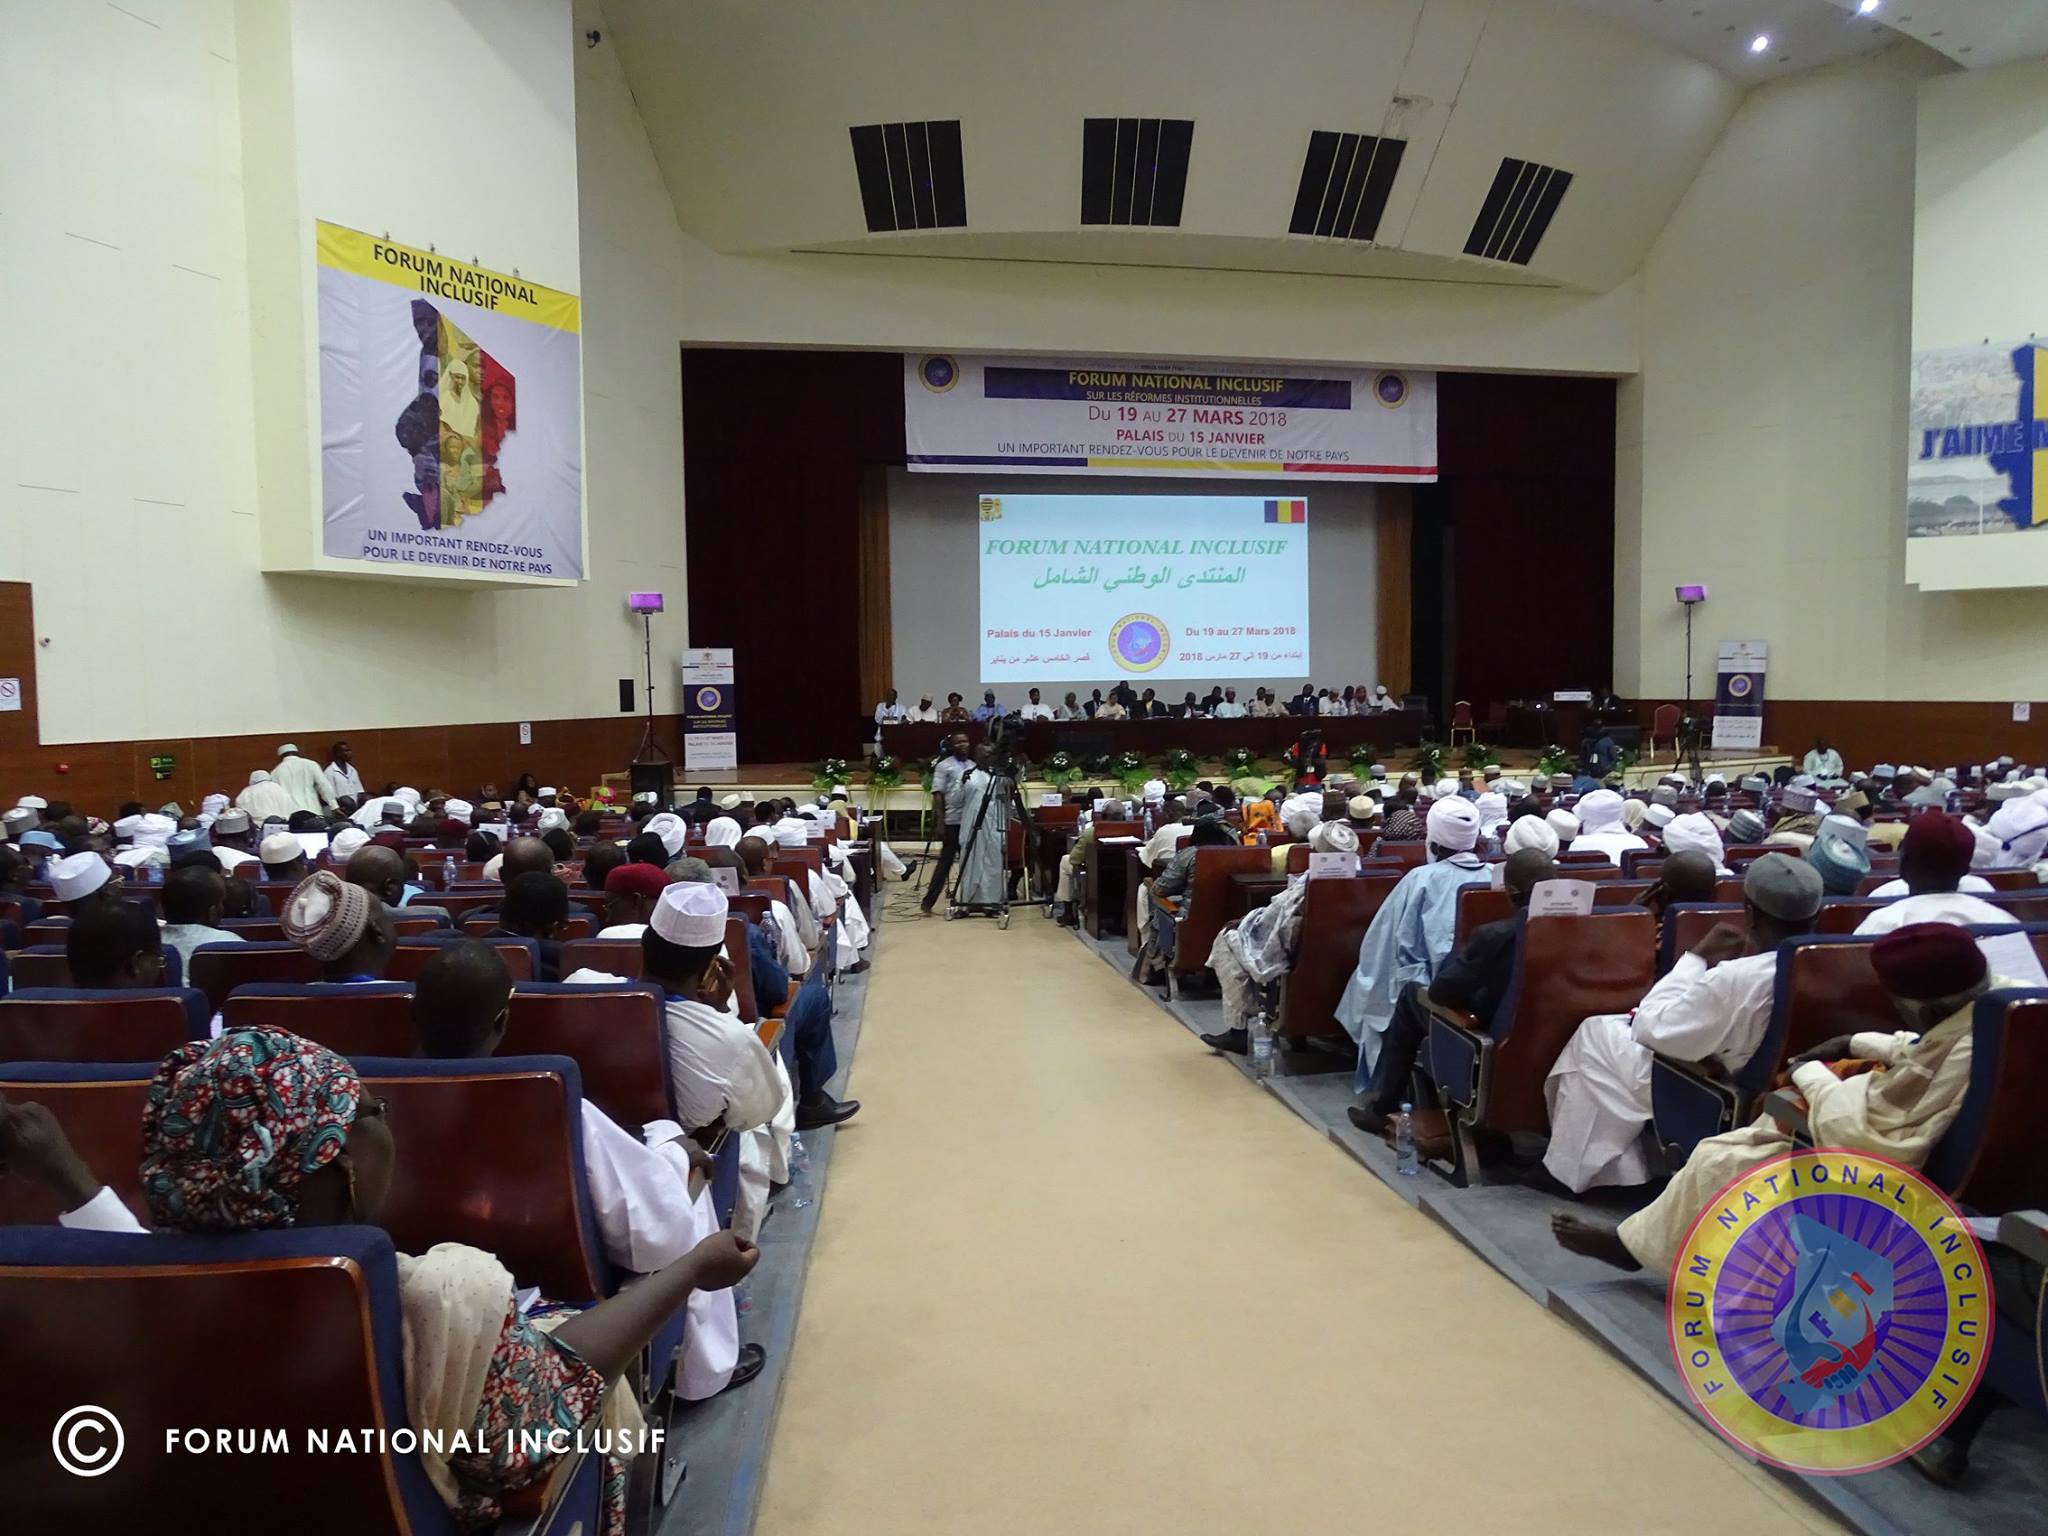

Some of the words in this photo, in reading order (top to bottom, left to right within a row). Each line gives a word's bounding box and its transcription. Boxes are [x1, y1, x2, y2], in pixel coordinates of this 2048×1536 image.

[373, 244, 443, 278] FORUM
[450, 265, 538, 305] NATIONAL
[420, 276, 500, 310] INCLUSIF
[1069, 371, 1126, 387] FORUM
[1132, 374, 1212, 391] NATIONAL
[1216, 378, 1284, 393] INCLUSIF
[1086, 391, 1105, 400] SUR
[1107, 392, 1122, 401] LES
[1124, 390, 1172, 403] RÉFORMES
[1118, 406, 1137, 422] 19
[1142, 411, 1161, 422] AU
[1167, 408, 1187, 423] 27
[1193, 409, 1244, 425] MARS
[1249, 412, 1287, 427] 2018
[1116, 429, 1164, 442] PALAIS
[1169, 432, 1185, 443] DU
[1189, 431, 1204, 443] 15
[1208, 433, 1265, 445] JANVIER
[998, 442, 1015, 453] UN
[1019, 443, 1085, 455] IMPORTANT
[1089, 445, 1168, 457] RENDEZ-VOUS
[1172, 447, 1201, 457] POUR
[1206, 448, 1218, 457] LE
[1221, 448, 1266, 459] DEVENIR
[1270, 449, 1283, 459] DE
[1287, 450, 1322, 461] NOTRE
[1325, 451, 1350, 461] PAYS
[368, 529, 387, 542] UN
[391, 532, 462, 550] IMPORTANT
[466, 541, 543, 559] RENDEZ-VOUS
[985, 539, 1068, 555] FORUM
[1073, 539, 1184, 555] NATIONAL
[1189, 539, 1288, 555] INCLUSIF
[363, 546, 398, 560] POUR
[402, 550, 414, 561] LE
[418, 551, 469, 566] DEVENIR
[472, 557, 486, 568] DE
[489, 559, 525, 572] NOTRE
[528, 563, 553, 575] PAYS
[987, 629, 1019, 638] Palais
[1022, 629, 1035, 637] du
[1039, 629, 1051, 637] 15
[1053, 628, 1092, 637] Janvier
[1185, 627, 1199, 636] Du
[1203, 627, 1214, 636] 19
[1217, 628, 1229, 636] au
[1231, 627, 1243, 636] 27
[1246, 627, 1270, 635] Mars
[1273, 626, 1296, 635] 2018
[1179, 652, 1203, 661] 2018
[1229, 652, 1241, 660] 27
[1257, 652, 1268, 660] 19
